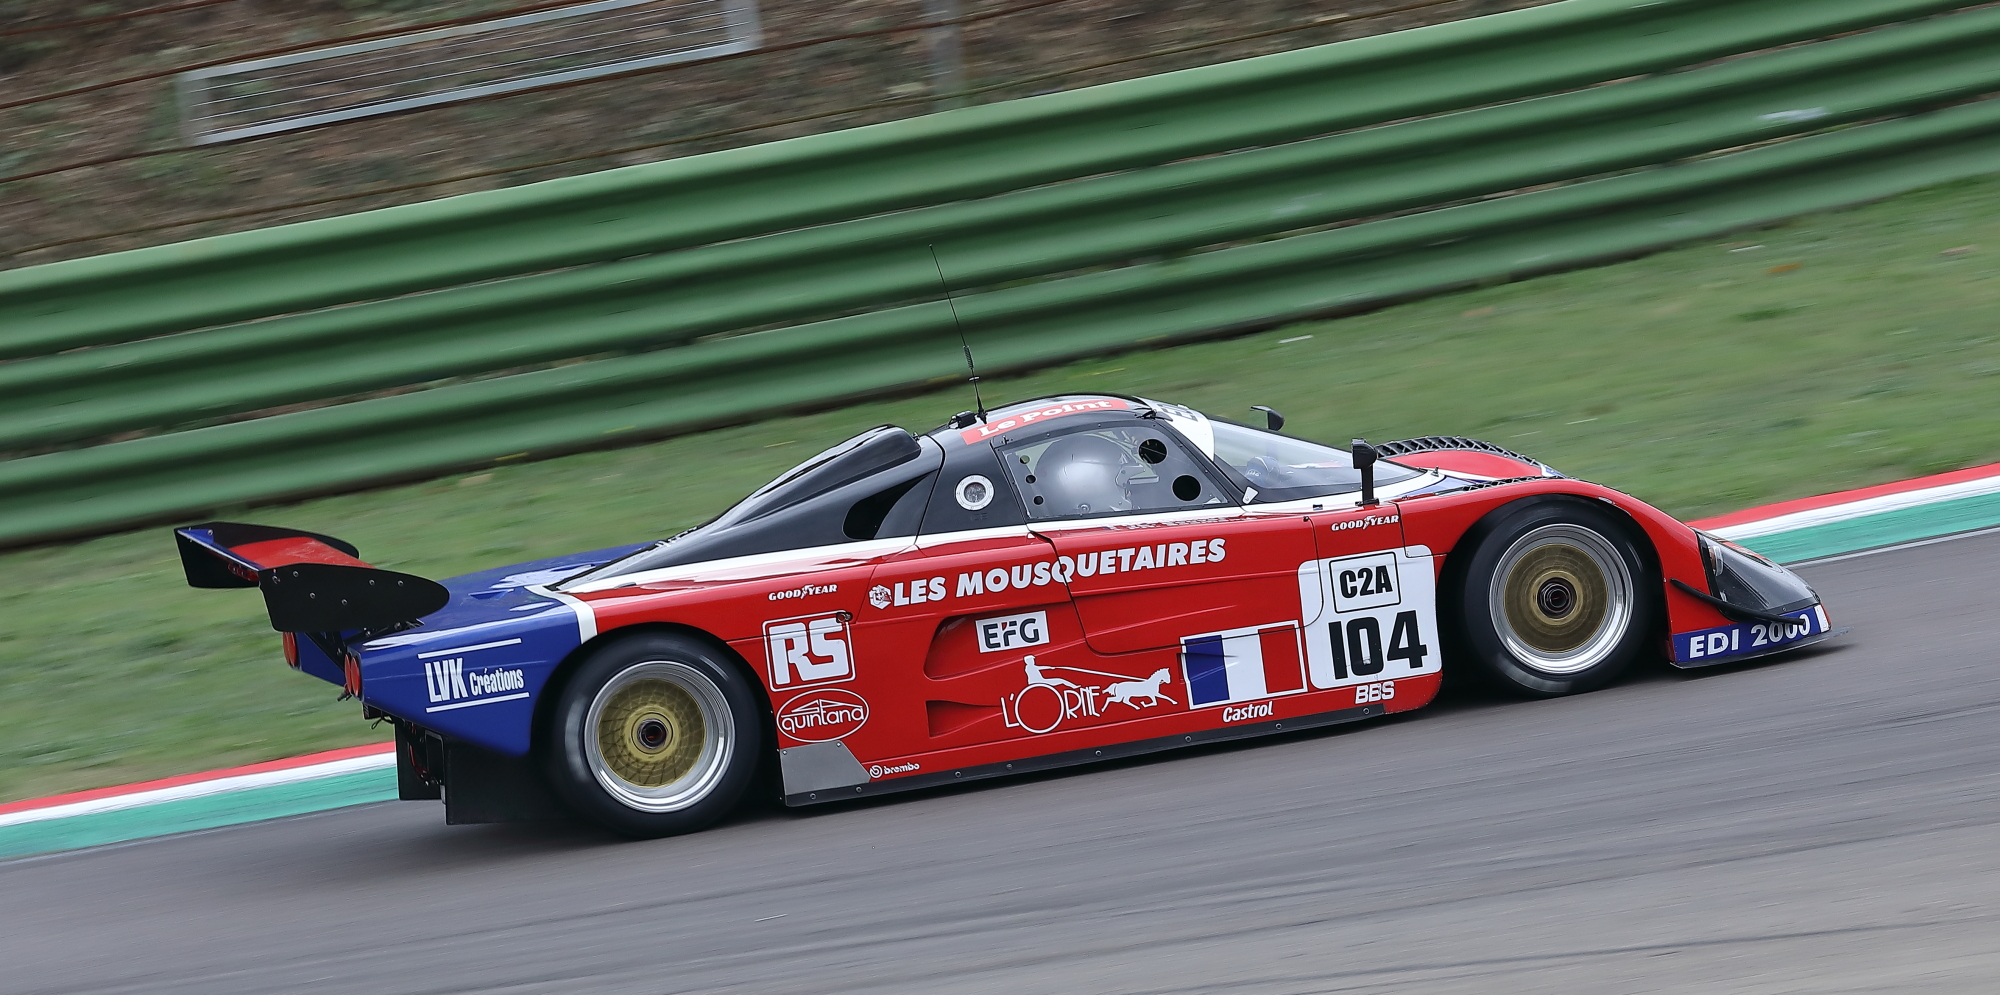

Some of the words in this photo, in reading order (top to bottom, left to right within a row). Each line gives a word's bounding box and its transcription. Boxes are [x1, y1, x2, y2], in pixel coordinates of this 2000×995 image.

[977, 420, 1017, 437] Le
[1020, 401, 1112, 423] Point
[893, 577, 946, 607] LES
[956, 538, 1226, 598] MOUSQUETAIRES
[1339, 565, 1393, 599] C2A
[983, 617, 1040, 650] EFG
[1328, 610, 1428, 680] 104
[1689, 628, 1740, 659] EDI
[769, 618, 851, 686] RS
[424, 657, 468, 703] LVK
[469, 667, 525, 697] Créations
[1355, 681, 1395, 704] BBS
[781, 698, 865, 733] quintana
[1222, 701, 1274, 723] Castrol
[883, 762, 921, 776] brembo
